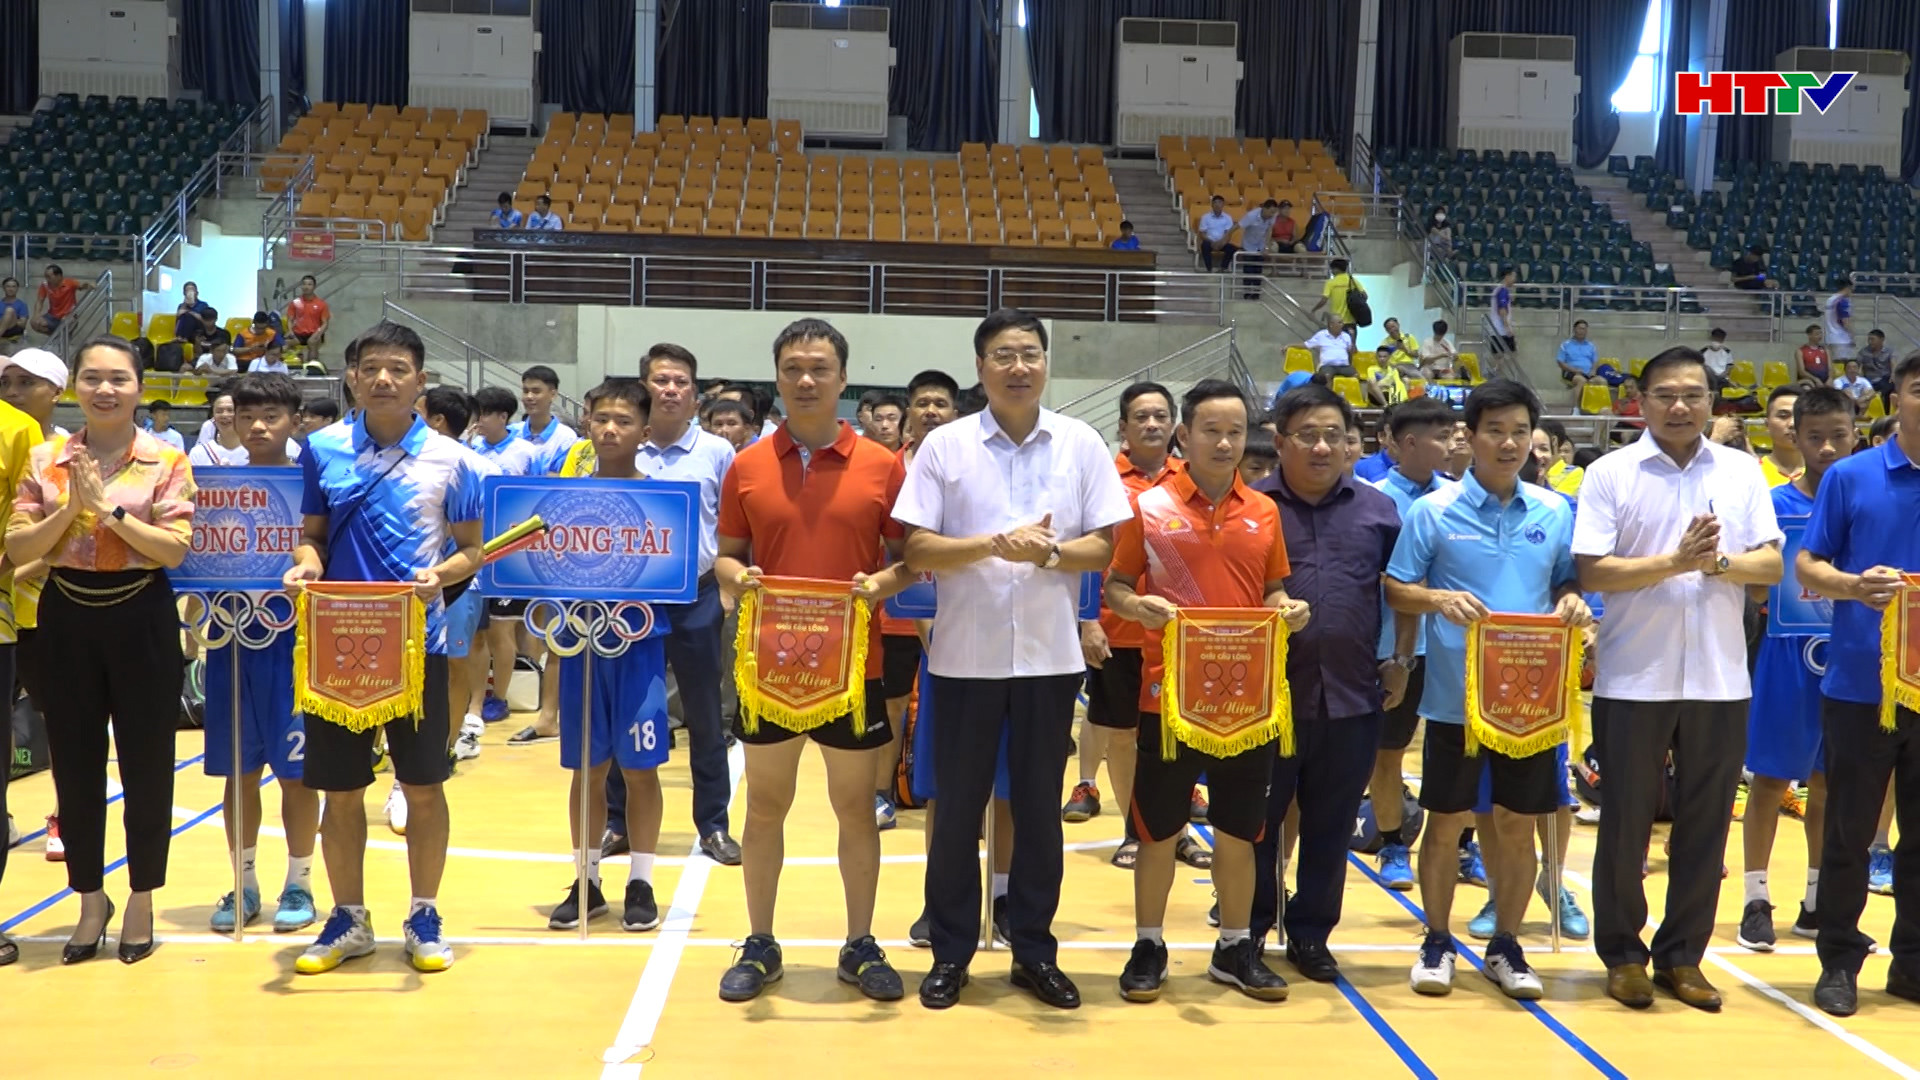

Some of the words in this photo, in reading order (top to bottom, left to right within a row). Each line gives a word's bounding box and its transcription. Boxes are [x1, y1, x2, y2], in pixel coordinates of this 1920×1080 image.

[197, 486, 268, 513] HUYỆN
[190, 523, 247, 553] ƠNG
[256, 524, 304, 553] KH
[621, 521, 672, 555] TÀI
[629, 719, 656, 752] 18
